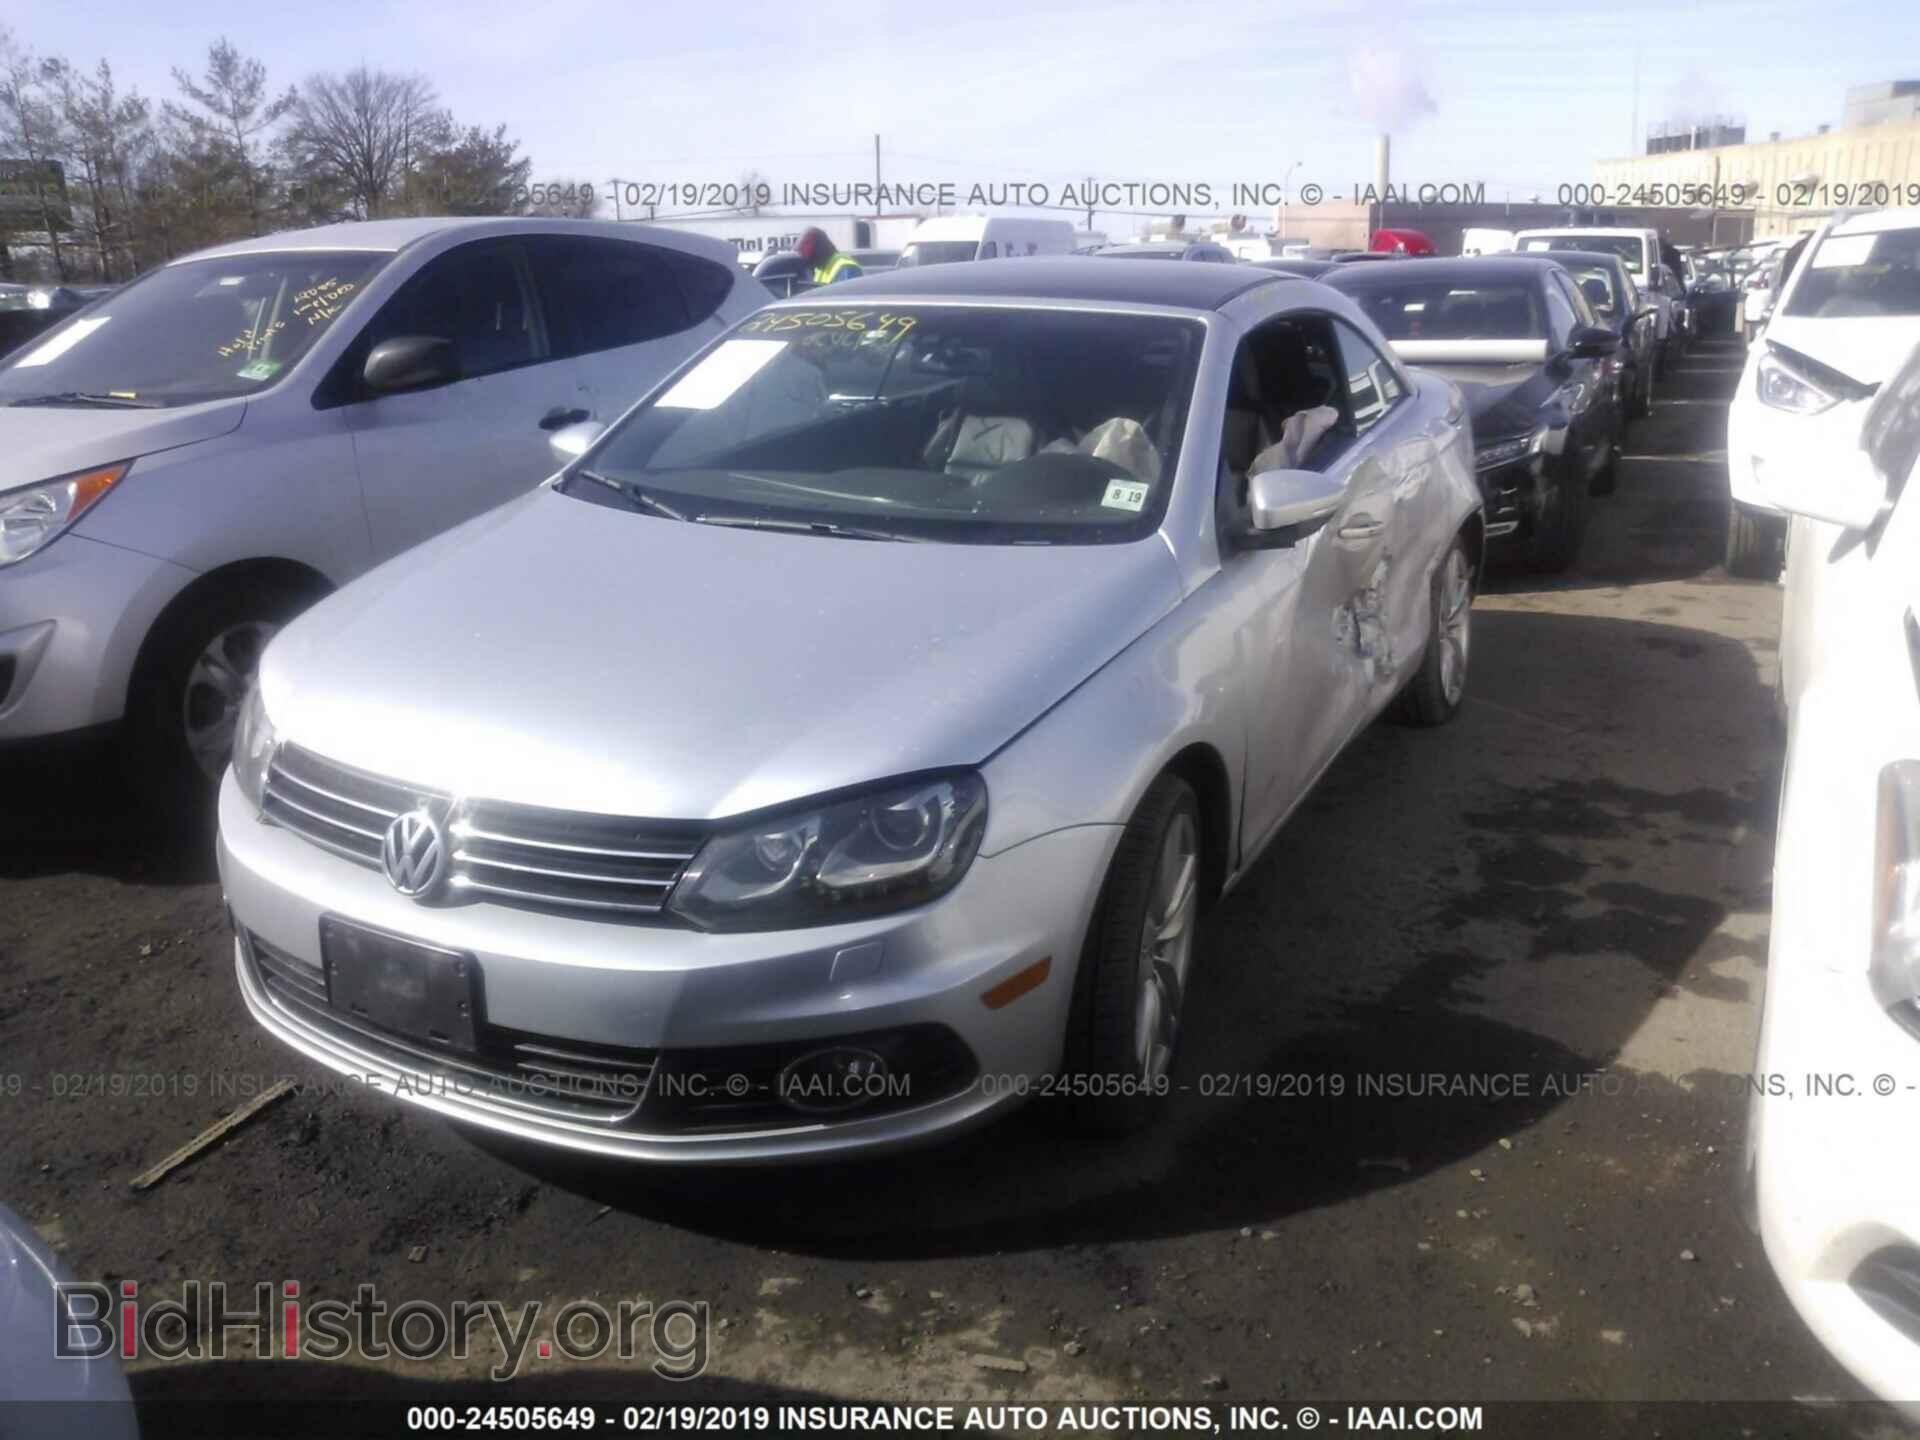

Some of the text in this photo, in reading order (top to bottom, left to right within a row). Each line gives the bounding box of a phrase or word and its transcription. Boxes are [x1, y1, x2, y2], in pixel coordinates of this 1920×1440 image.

[1112, 489, 1142, 503] 8 19
[383, 811, 440, 893] VW
